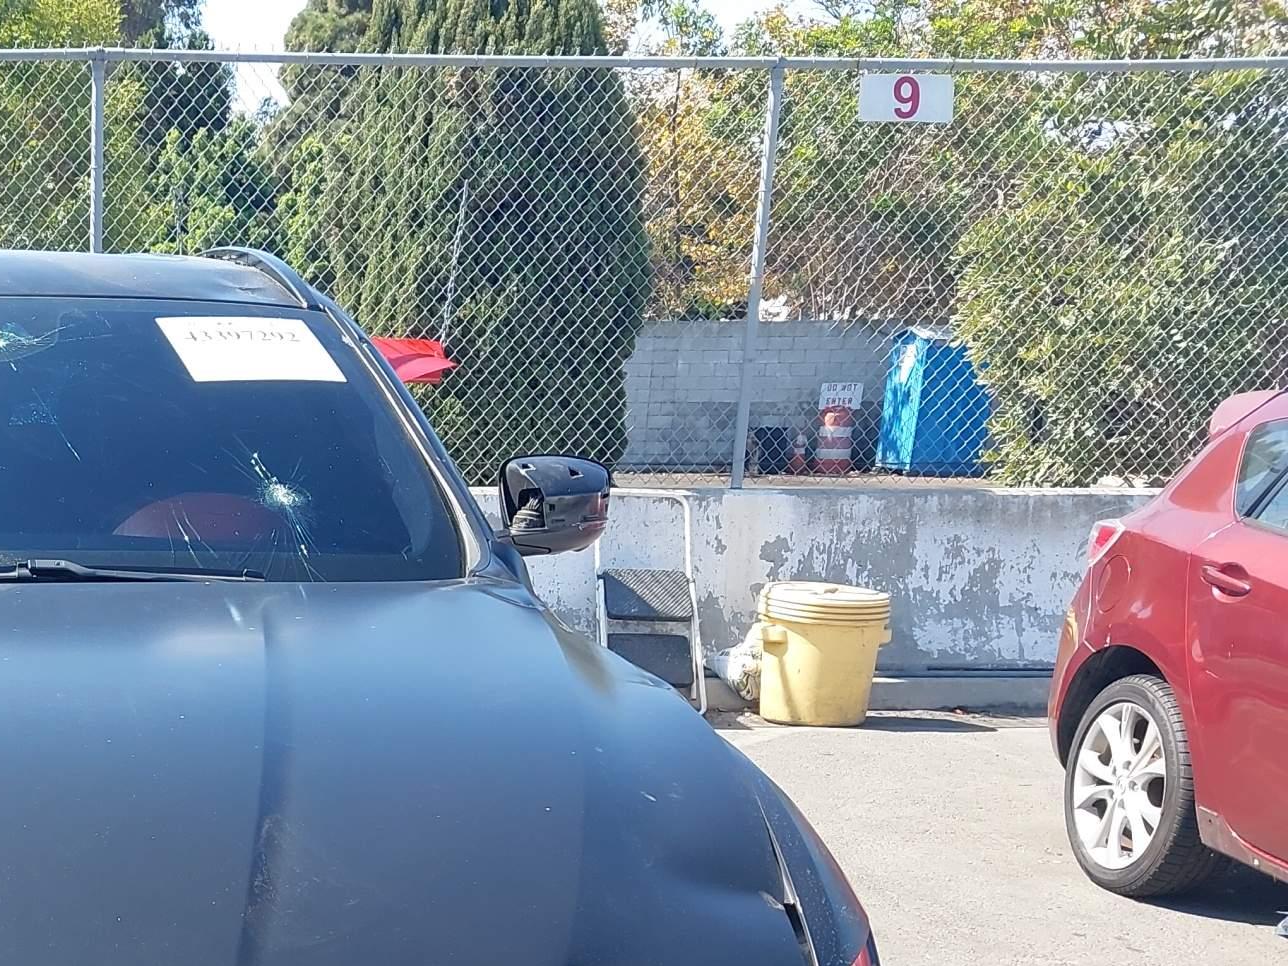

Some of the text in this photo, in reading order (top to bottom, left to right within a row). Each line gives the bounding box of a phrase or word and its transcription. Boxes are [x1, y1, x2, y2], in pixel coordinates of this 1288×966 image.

[893, 75, 921, 120] 9
[827, 383, 858, 392] DO NOT
[825, 397, 853, 405] ENTER
